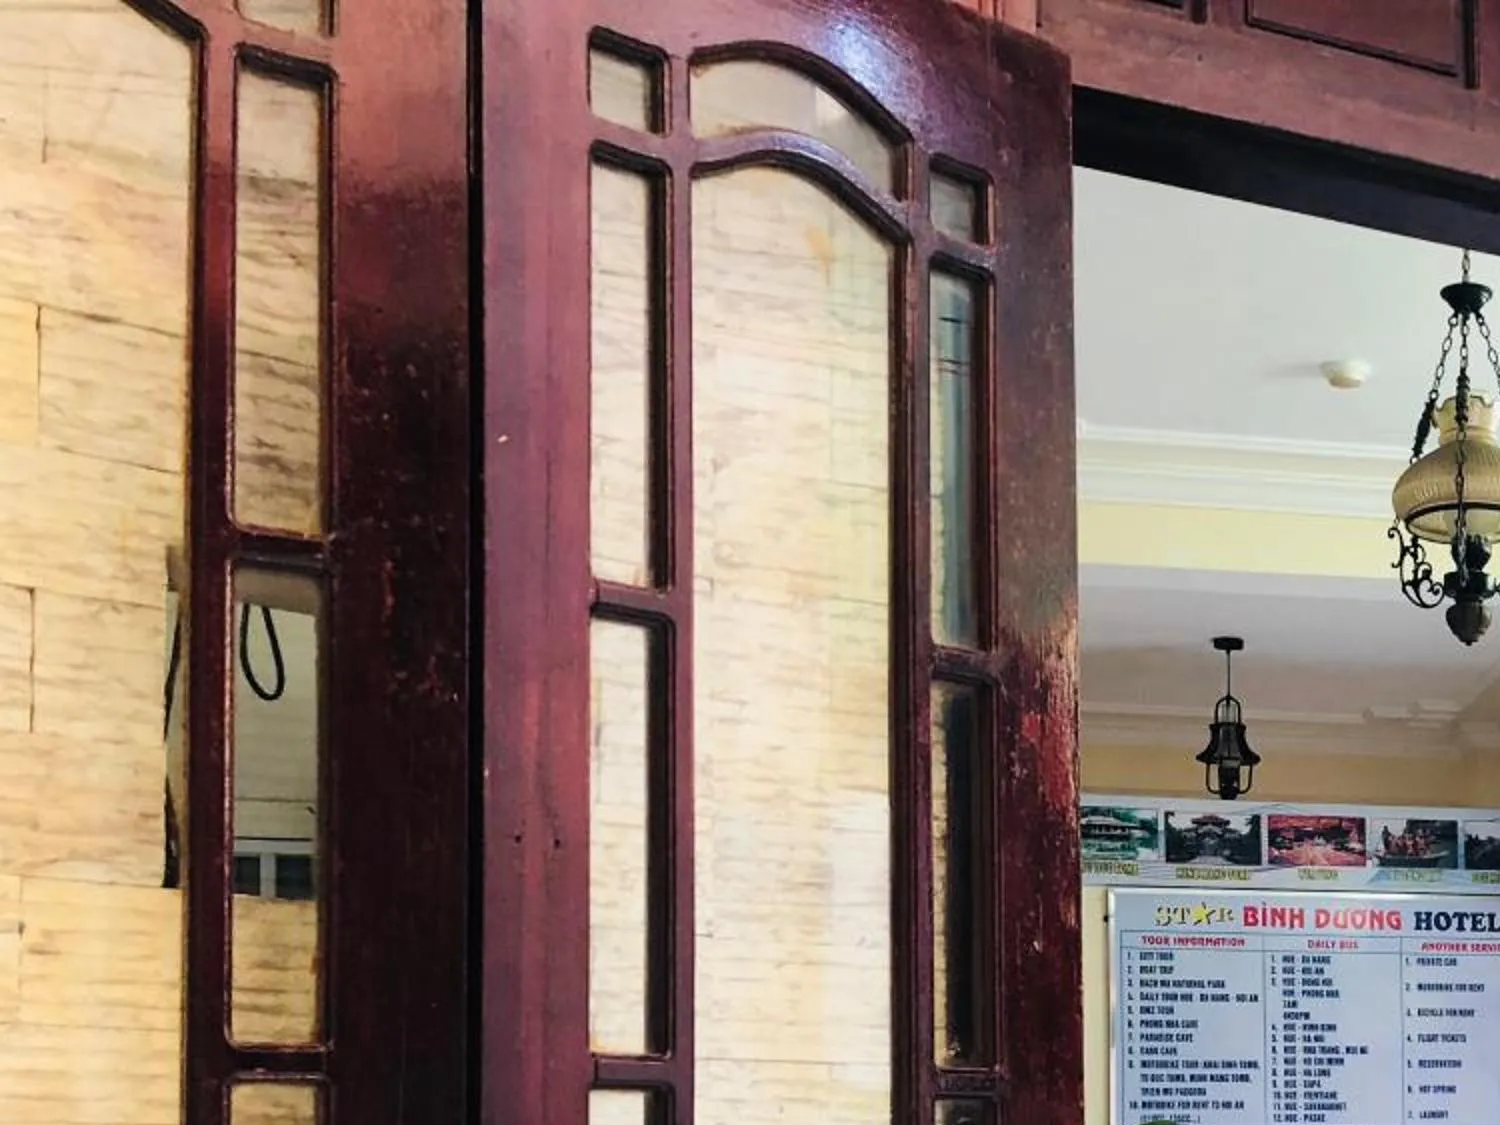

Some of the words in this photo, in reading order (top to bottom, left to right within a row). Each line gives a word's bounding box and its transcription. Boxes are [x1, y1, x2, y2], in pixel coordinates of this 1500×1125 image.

[1142, 936, 1170, 947] TOUR
[1174, 936, 1245, 947] INFORMATION
[1308, 939, 1336, 949] DAILY
[1340, 939, 1359, 949] BUS
[1421, 943, 1468, 952] ANOTHER
